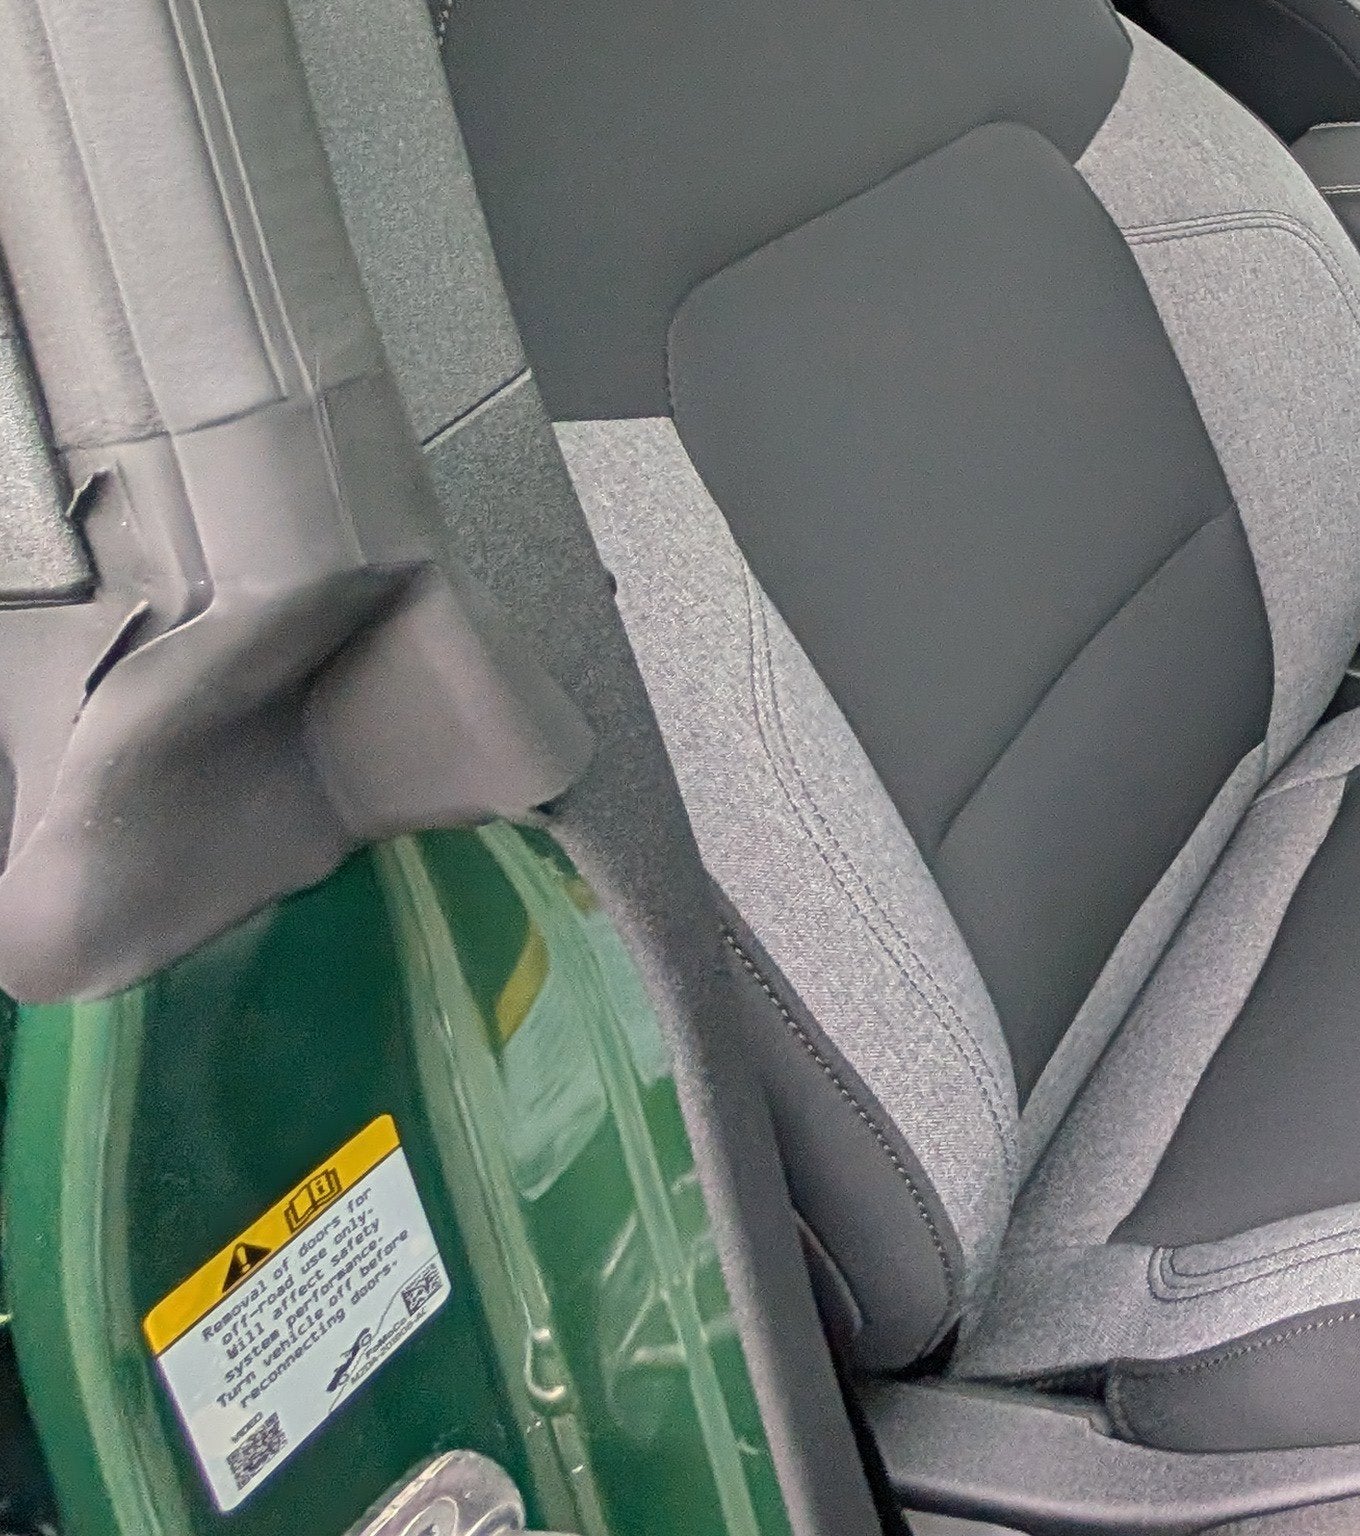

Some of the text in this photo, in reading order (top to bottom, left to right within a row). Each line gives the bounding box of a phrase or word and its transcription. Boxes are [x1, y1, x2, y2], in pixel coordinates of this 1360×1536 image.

[201, 1184, 372, 1342] Removal of doors for
[216, 1226, 408, 1410] Turn vehicle off before
[220, 1203, 374, 1346] off-road use only.
[223, 1229, 383, 1385] system performance.
[226, 1214, 381, 1361] Will affect safety
[240, 1255, 398, 1409] reconnecting doors.
[231, 1409, 263, 1444] VIDEO
